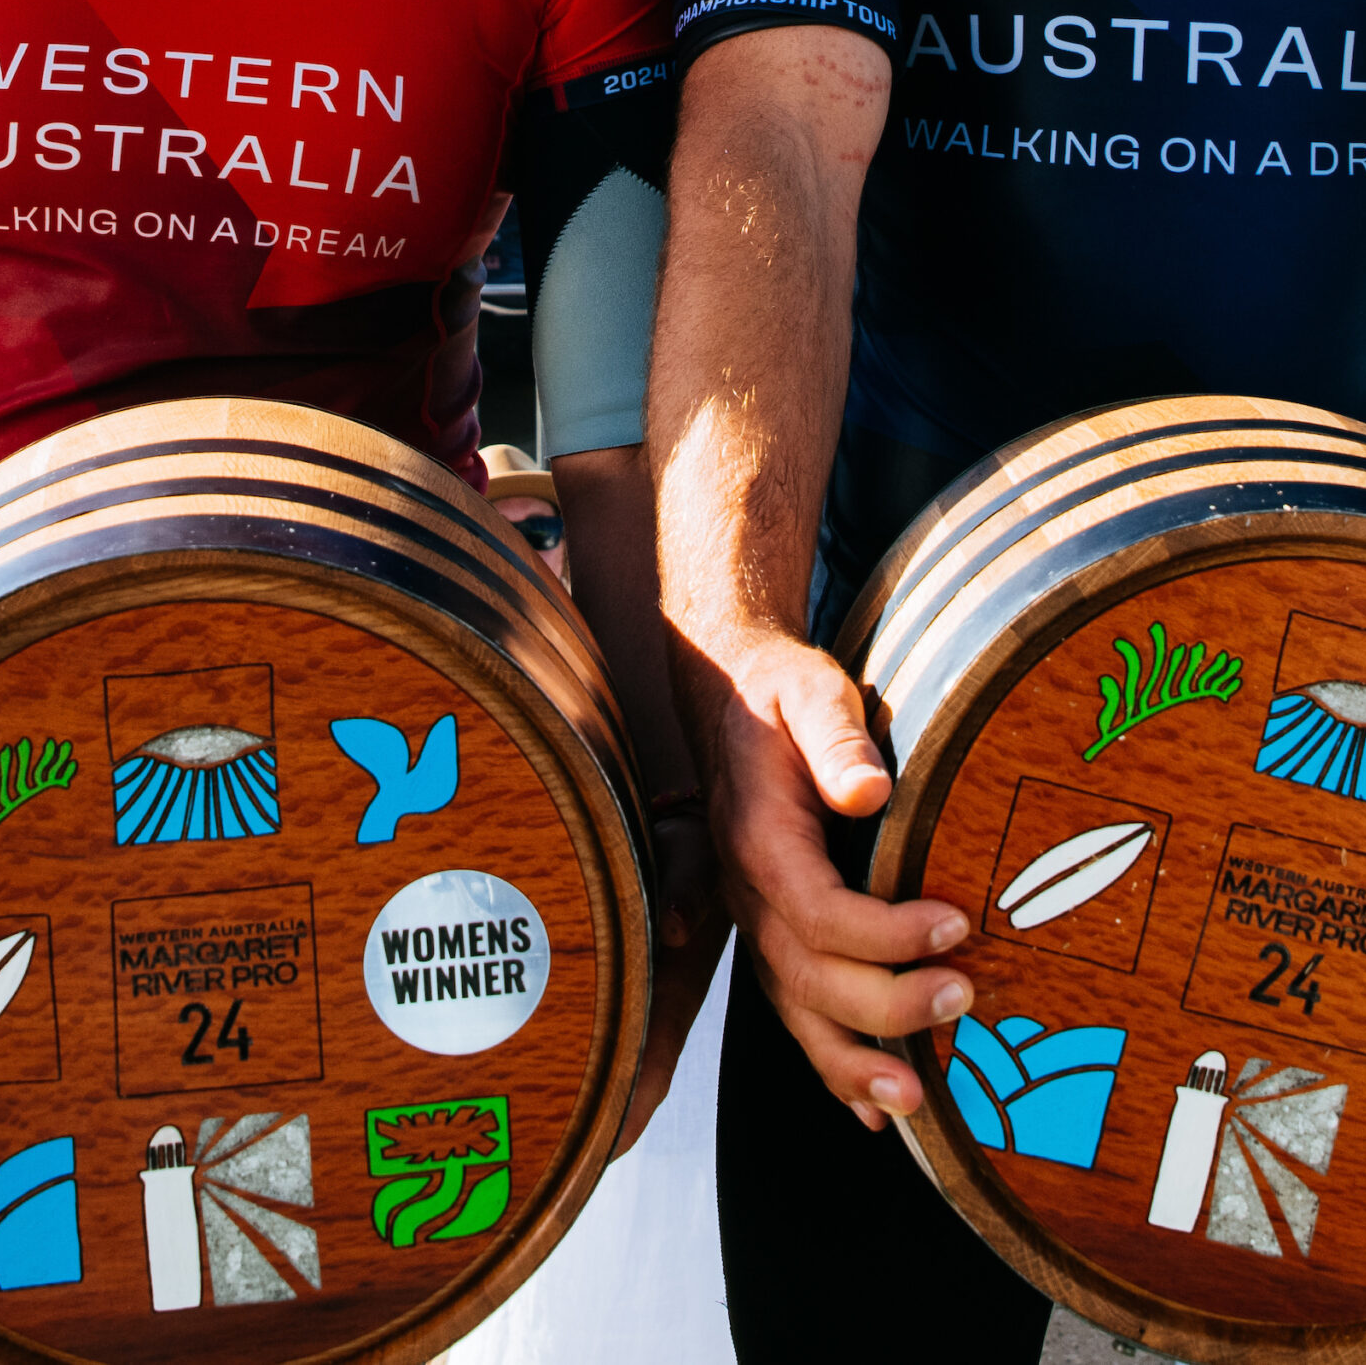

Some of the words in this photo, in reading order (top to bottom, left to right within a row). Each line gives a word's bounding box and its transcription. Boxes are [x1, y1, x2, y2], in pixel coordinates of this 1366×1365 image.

[603, 62, 667, 95] 2024
[904, 117, 1140, 170] WALKING
[1160, 137, 1236, 174] ON
[1256, 141, 1293, 175] A
[134, 211, 195, 241] ON
[210, 217, 239, 244] A
[253, 219, 407, 260] DREAM
[1228, 855, 1308, 886] WESTERN
[119, 927, 203, 945] WESTERN
[209, 918, 308, 938] AUSTRALIA
[381, 916, 532, 965] WOMENS
[1224, 898, 1316, 941] RIVER
[119, 934, 302, 972] MARGARET
[132, 967, 225, 997] RIVER
[232, 961, 299, 989] PRO
[391, 958, 527, 1005] WINNER
[1248, 942, 1325, 1016] 24
[178, 998, 254, 1066] 24
